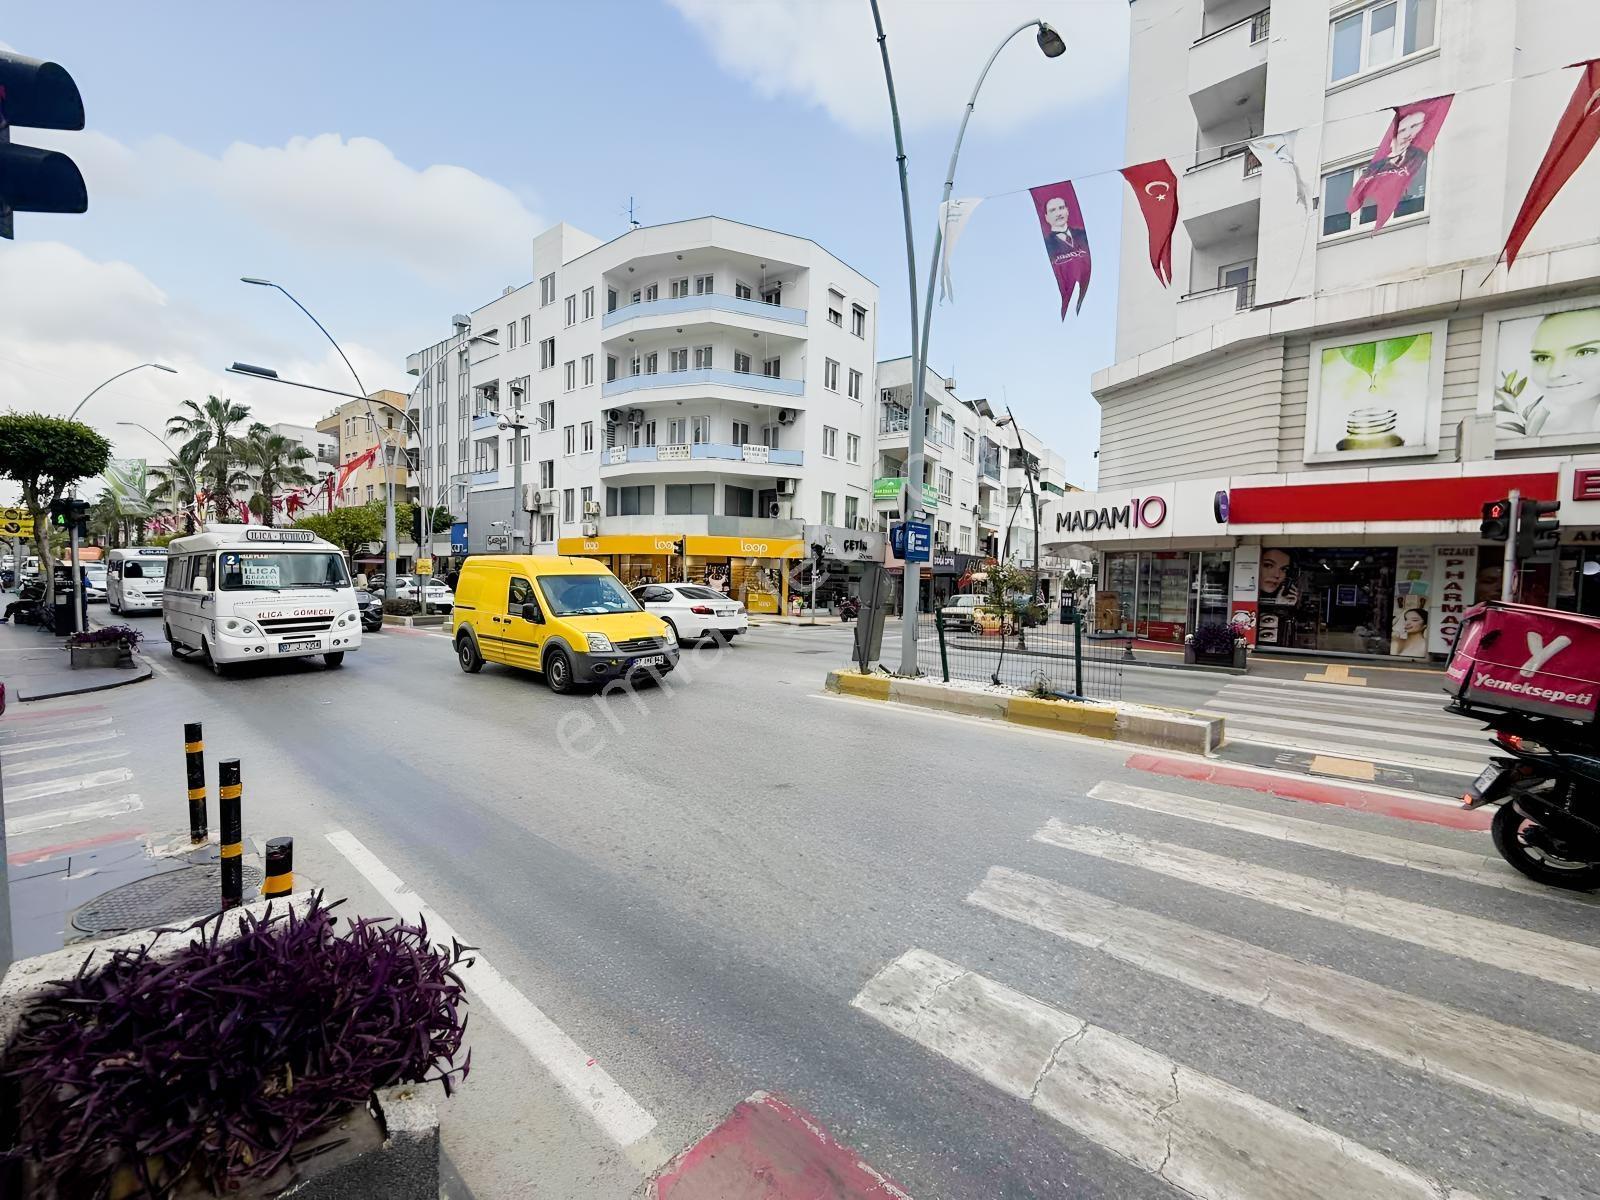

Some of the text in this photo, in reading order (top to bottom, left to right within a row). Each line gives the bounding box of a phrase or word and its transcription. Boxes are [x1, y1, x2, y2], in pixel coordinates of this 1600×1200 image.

[583, 540, 599, 551] loop
[654, 540, 675, 550] loo
[741, 540, 768, 554] loop
[227, 555, 235, 565] 2
[1520, 631, 1572, 678] Y
[1473, 672, 1593, 706] Yemeksepeti
